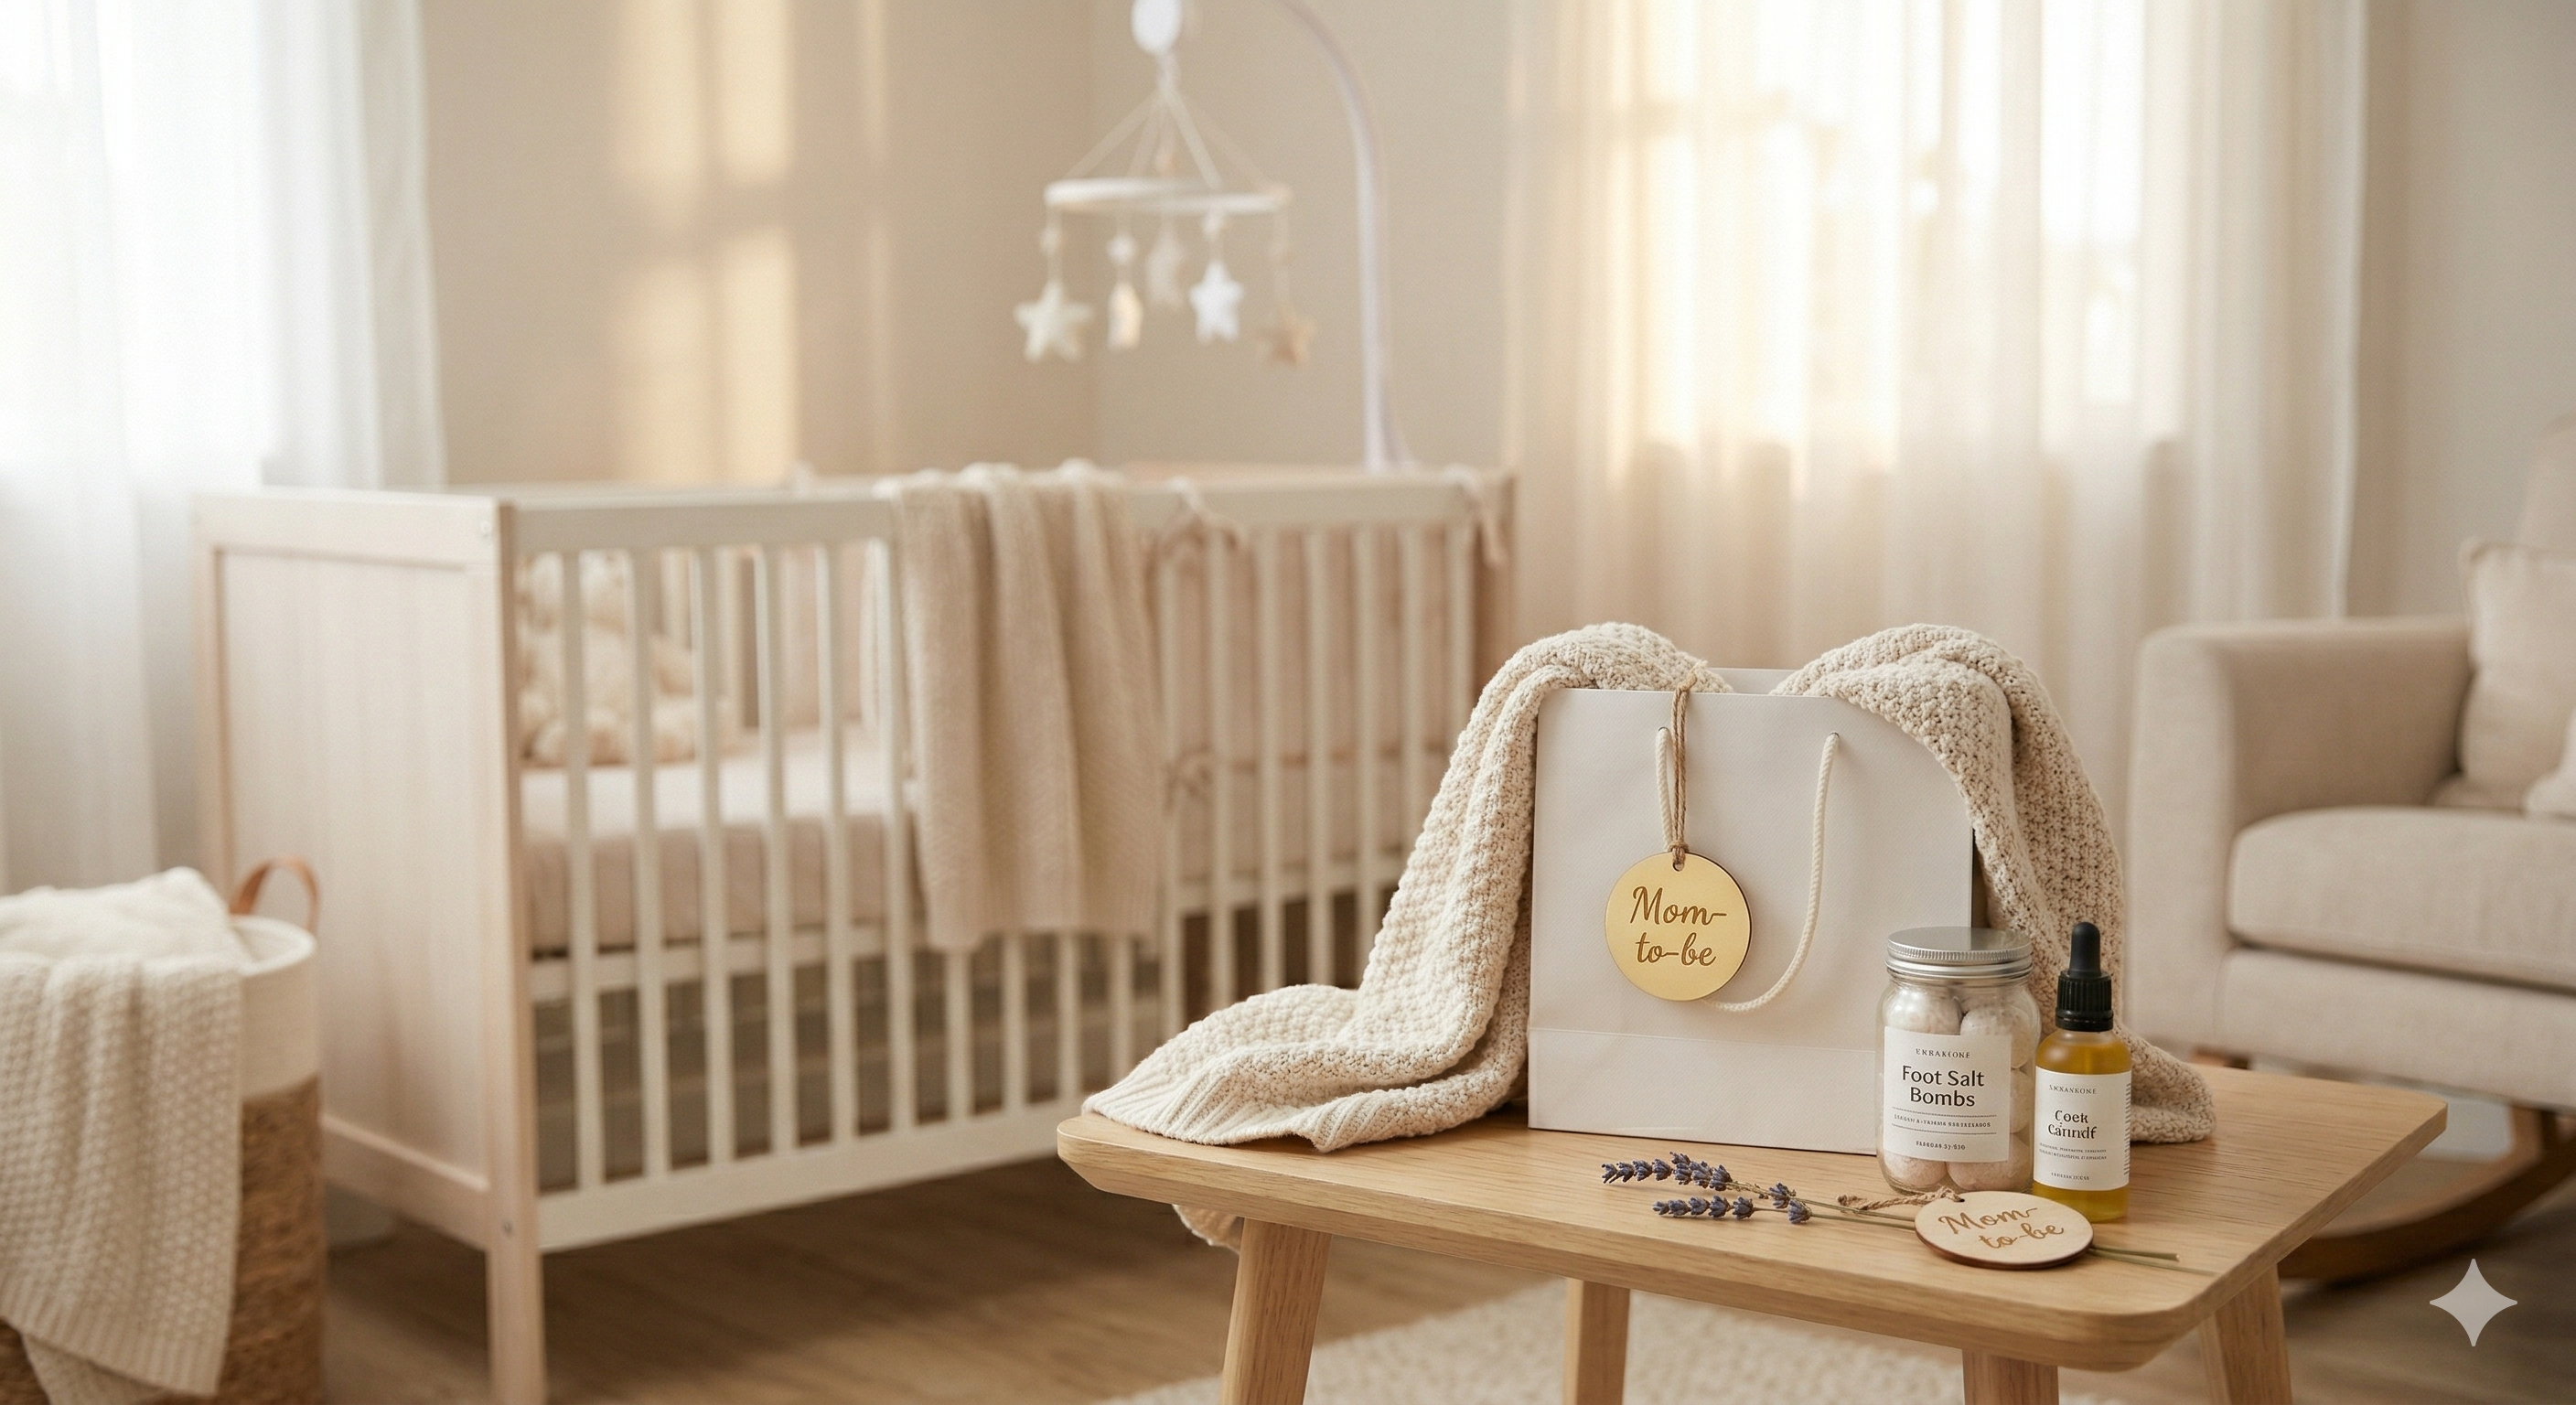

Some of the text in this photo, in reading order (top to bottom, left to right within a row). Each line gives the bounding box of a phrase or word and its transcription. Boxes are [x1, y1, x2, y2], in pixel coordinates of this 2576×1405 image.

[1629, 885, 1727, 926] Mom-
[1635, 931, 1717, 967] to-be
[1902, 1065, 1985, 1087] Foot Salt
[1910, 1087, 1975, 1107] Bombs
[1978, 1222, 2065, 1249] to-be
